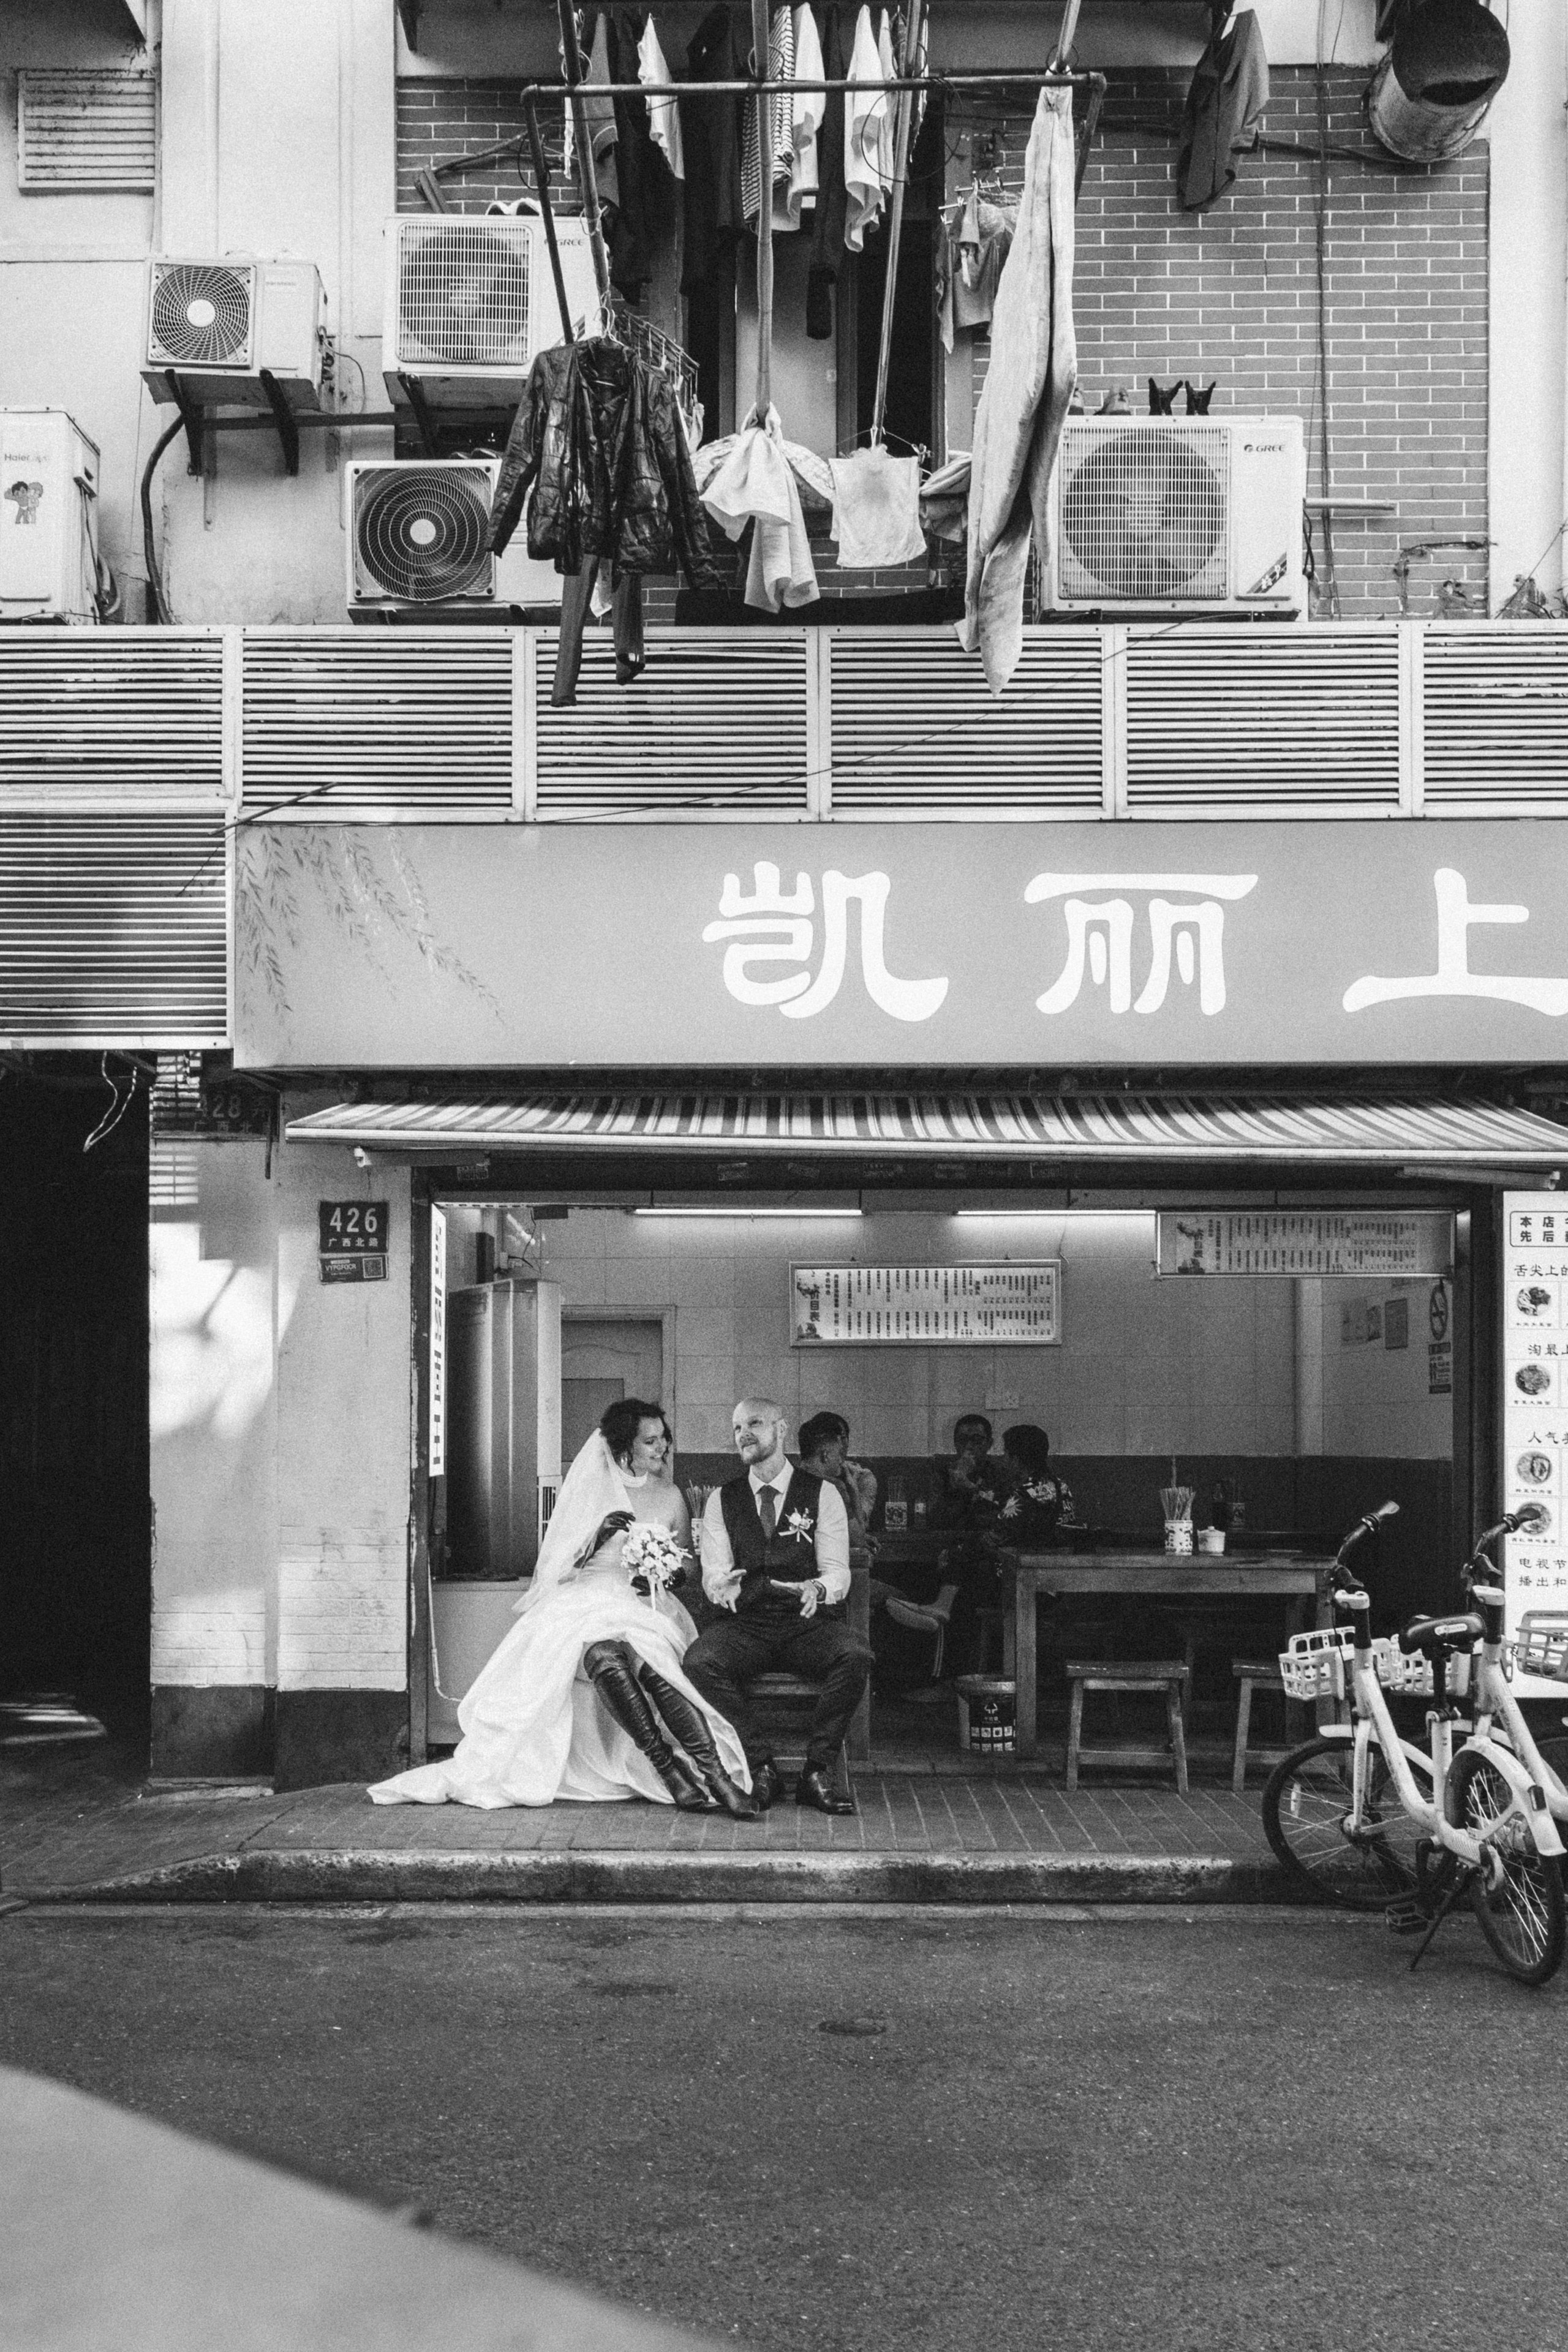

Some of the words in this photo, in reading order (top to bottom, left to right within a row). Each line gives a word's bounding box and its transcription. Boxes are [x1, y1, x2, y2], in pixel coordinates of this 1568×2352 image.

[330, 1207, 378, 1233] 426
[1520, 1215, 1568, 1228] 本店
[328, 1237, 379, 1247] 广西北路
[1520, 1230, 1568, 1243] 先后
[1519, 1558, 1567, 1570] 电视节
[1518, 1575, 1567, 1588] 播出和
